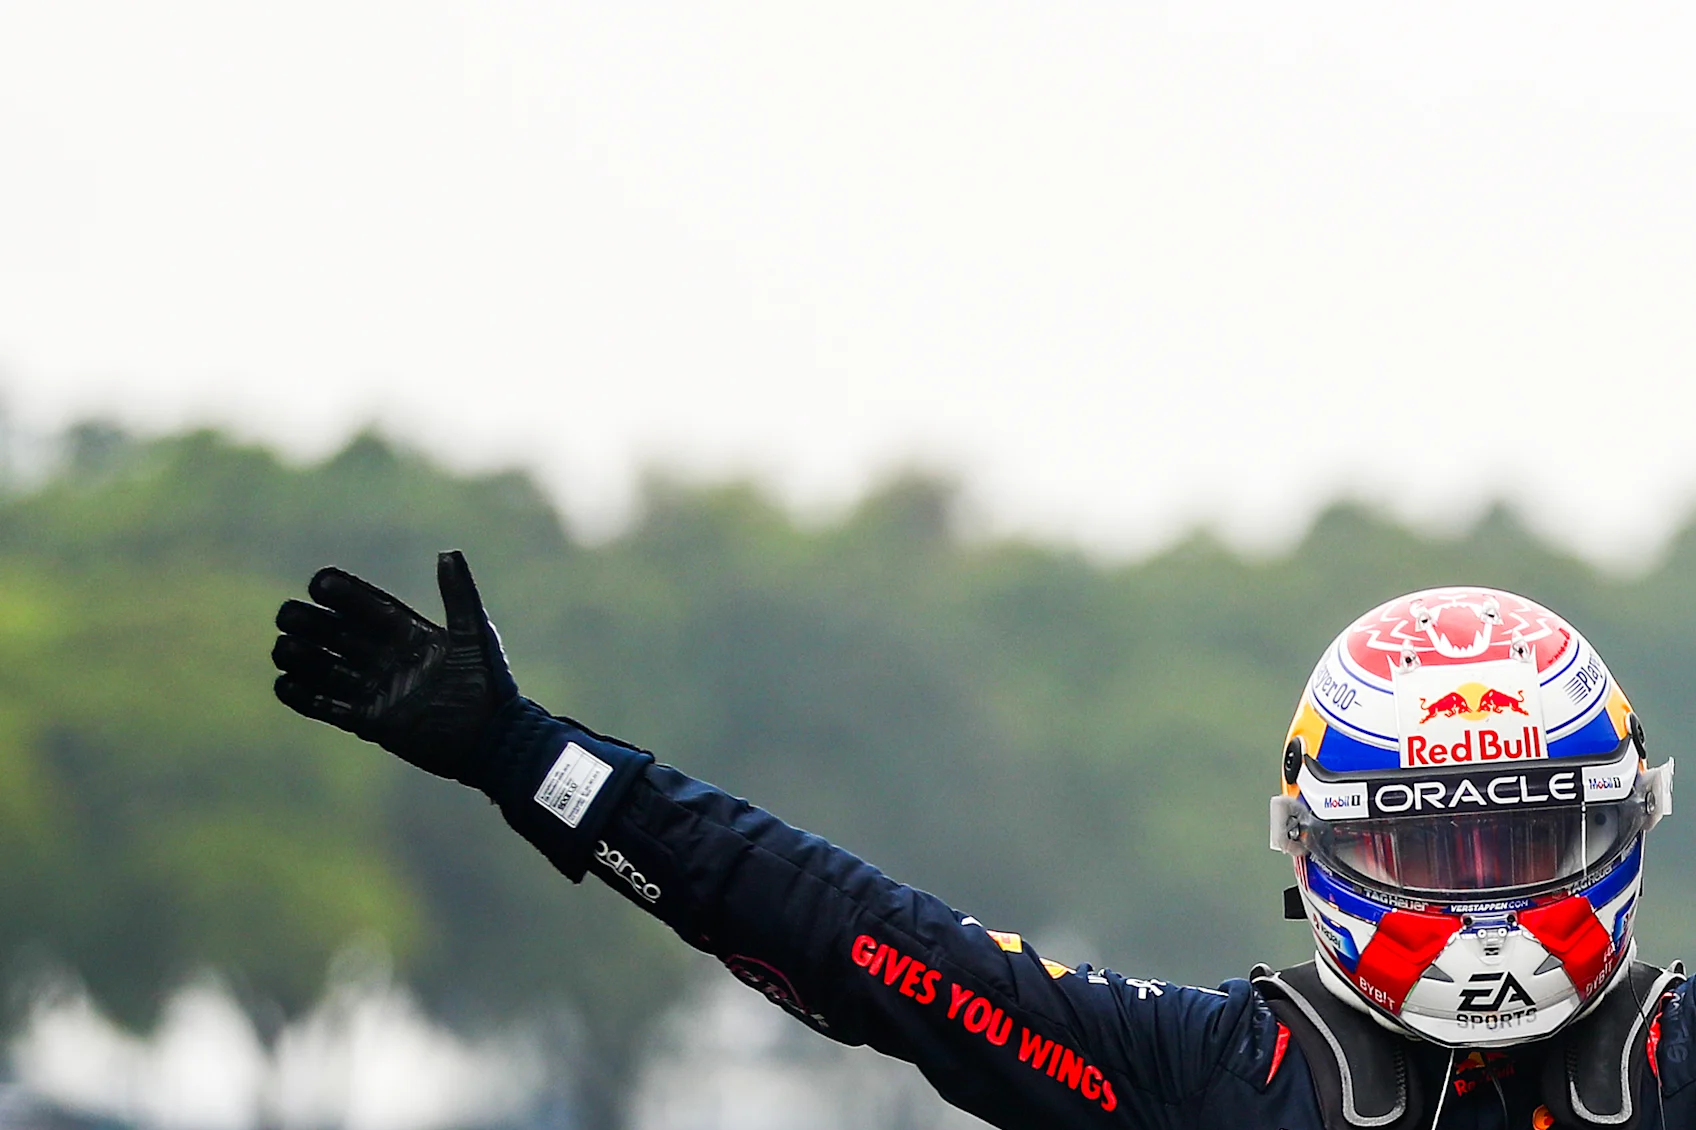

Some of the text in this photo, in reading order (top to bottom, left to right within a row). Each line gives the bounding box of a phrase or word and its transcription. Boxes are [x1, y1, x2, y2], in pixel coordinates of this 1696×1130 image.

[1407, 726, 1542, 766] Red Bull
[1324, 795, 1350, 809] Mobil
[1375, 772, 1577, 813] ORACLE
[594, 839, 661, 902] parco
[1450, 899, 1529, 913] VERSTAPPEN.COM
[1359, 975, 1396, 1010] BYBIT
[1457, 971, 1536, 1011] EA
[851, 933, 943, 1005] GIVES
[946, 982, 1013, 1047] YOU
[1017, 1025, 1118, 1112] WINGS
[1456, 1007, 1538, 1030] SPORTS
